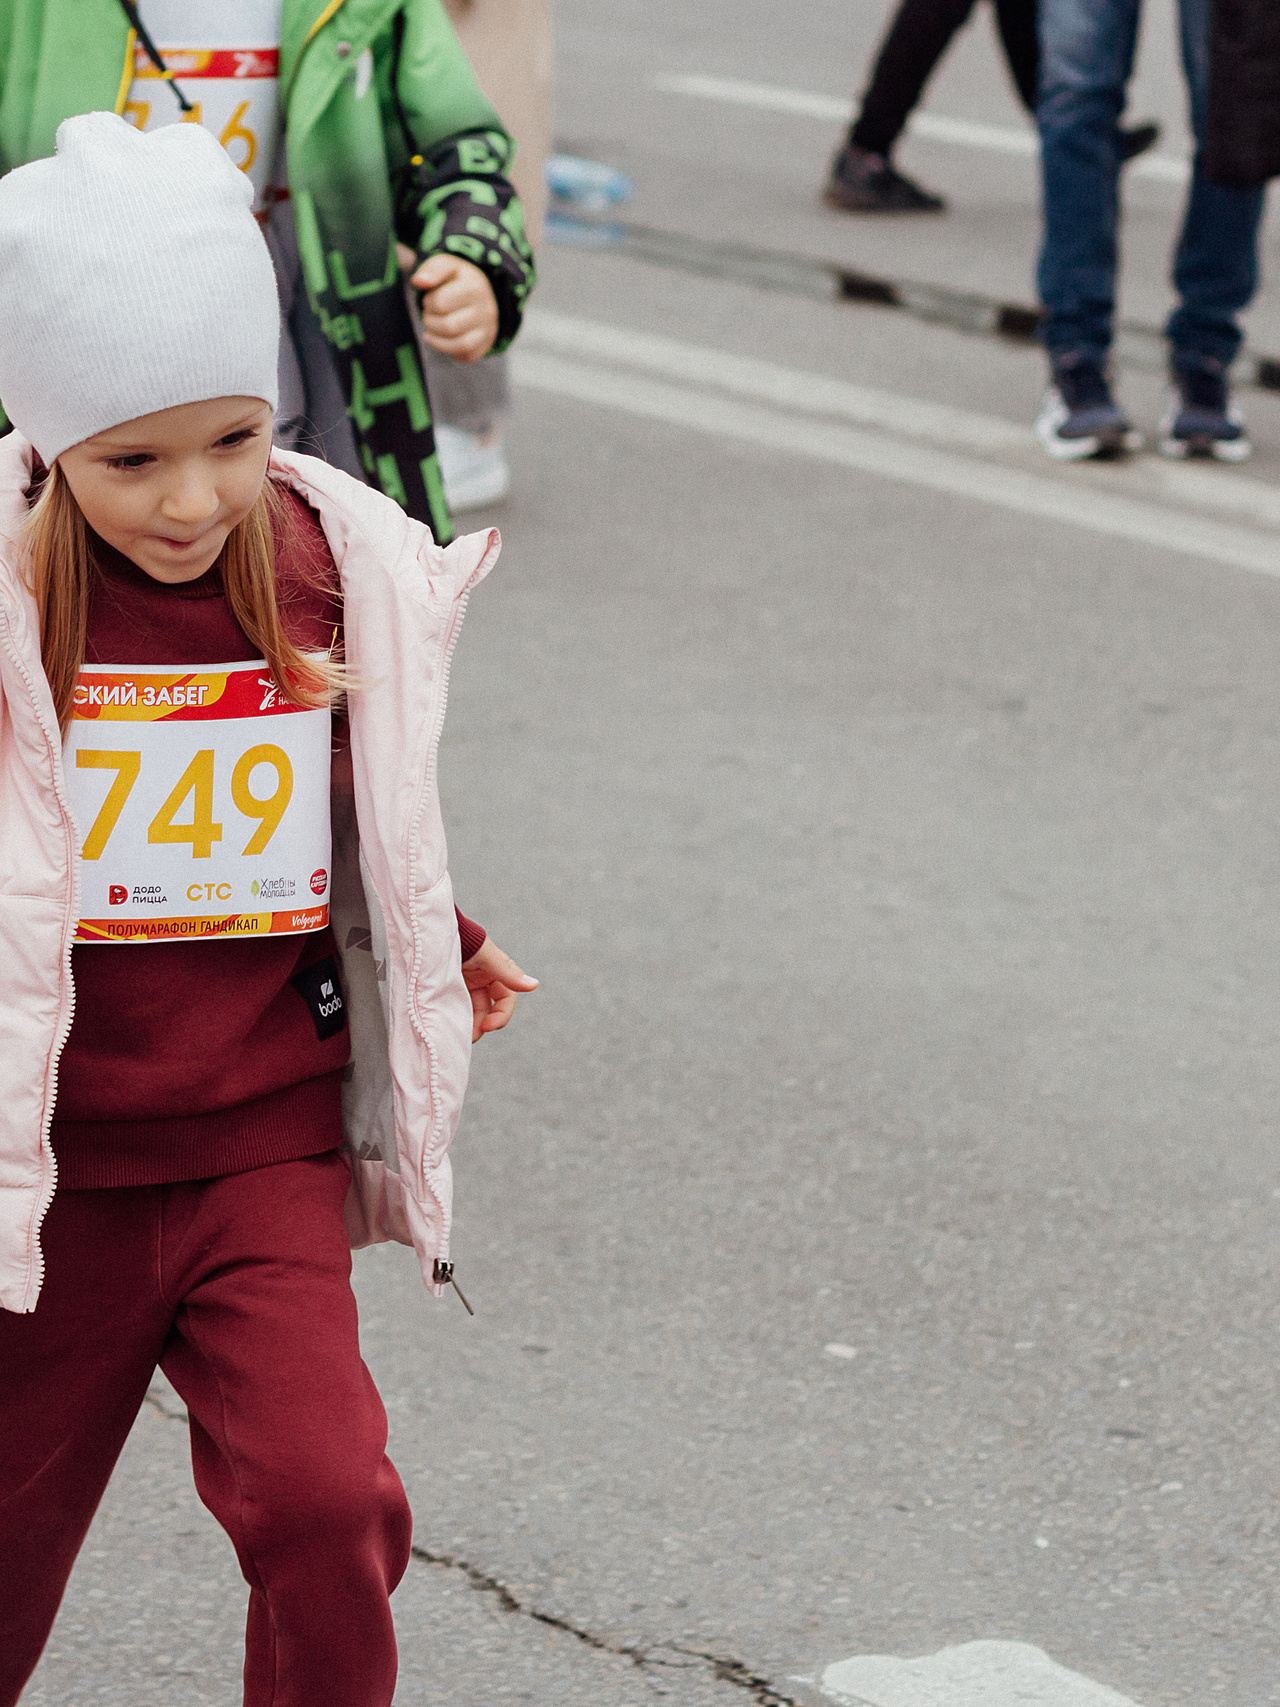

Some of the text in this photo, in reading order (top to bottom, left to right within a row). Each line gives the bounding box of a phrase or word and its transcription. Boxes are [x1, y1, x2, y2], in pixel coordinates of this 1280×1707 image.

[142, 685, 209, 706] ЗАБЕГ
[75, 743, 294, 861] 749
[132, 885, 162, 896] ДОДО
[132, 895, 168, 904] ПИЦЦА
[186, 882, 233, 902] СТС
[107, 918, 258, 936] ПОЛУМАРАФОН ГАНДИКАП
